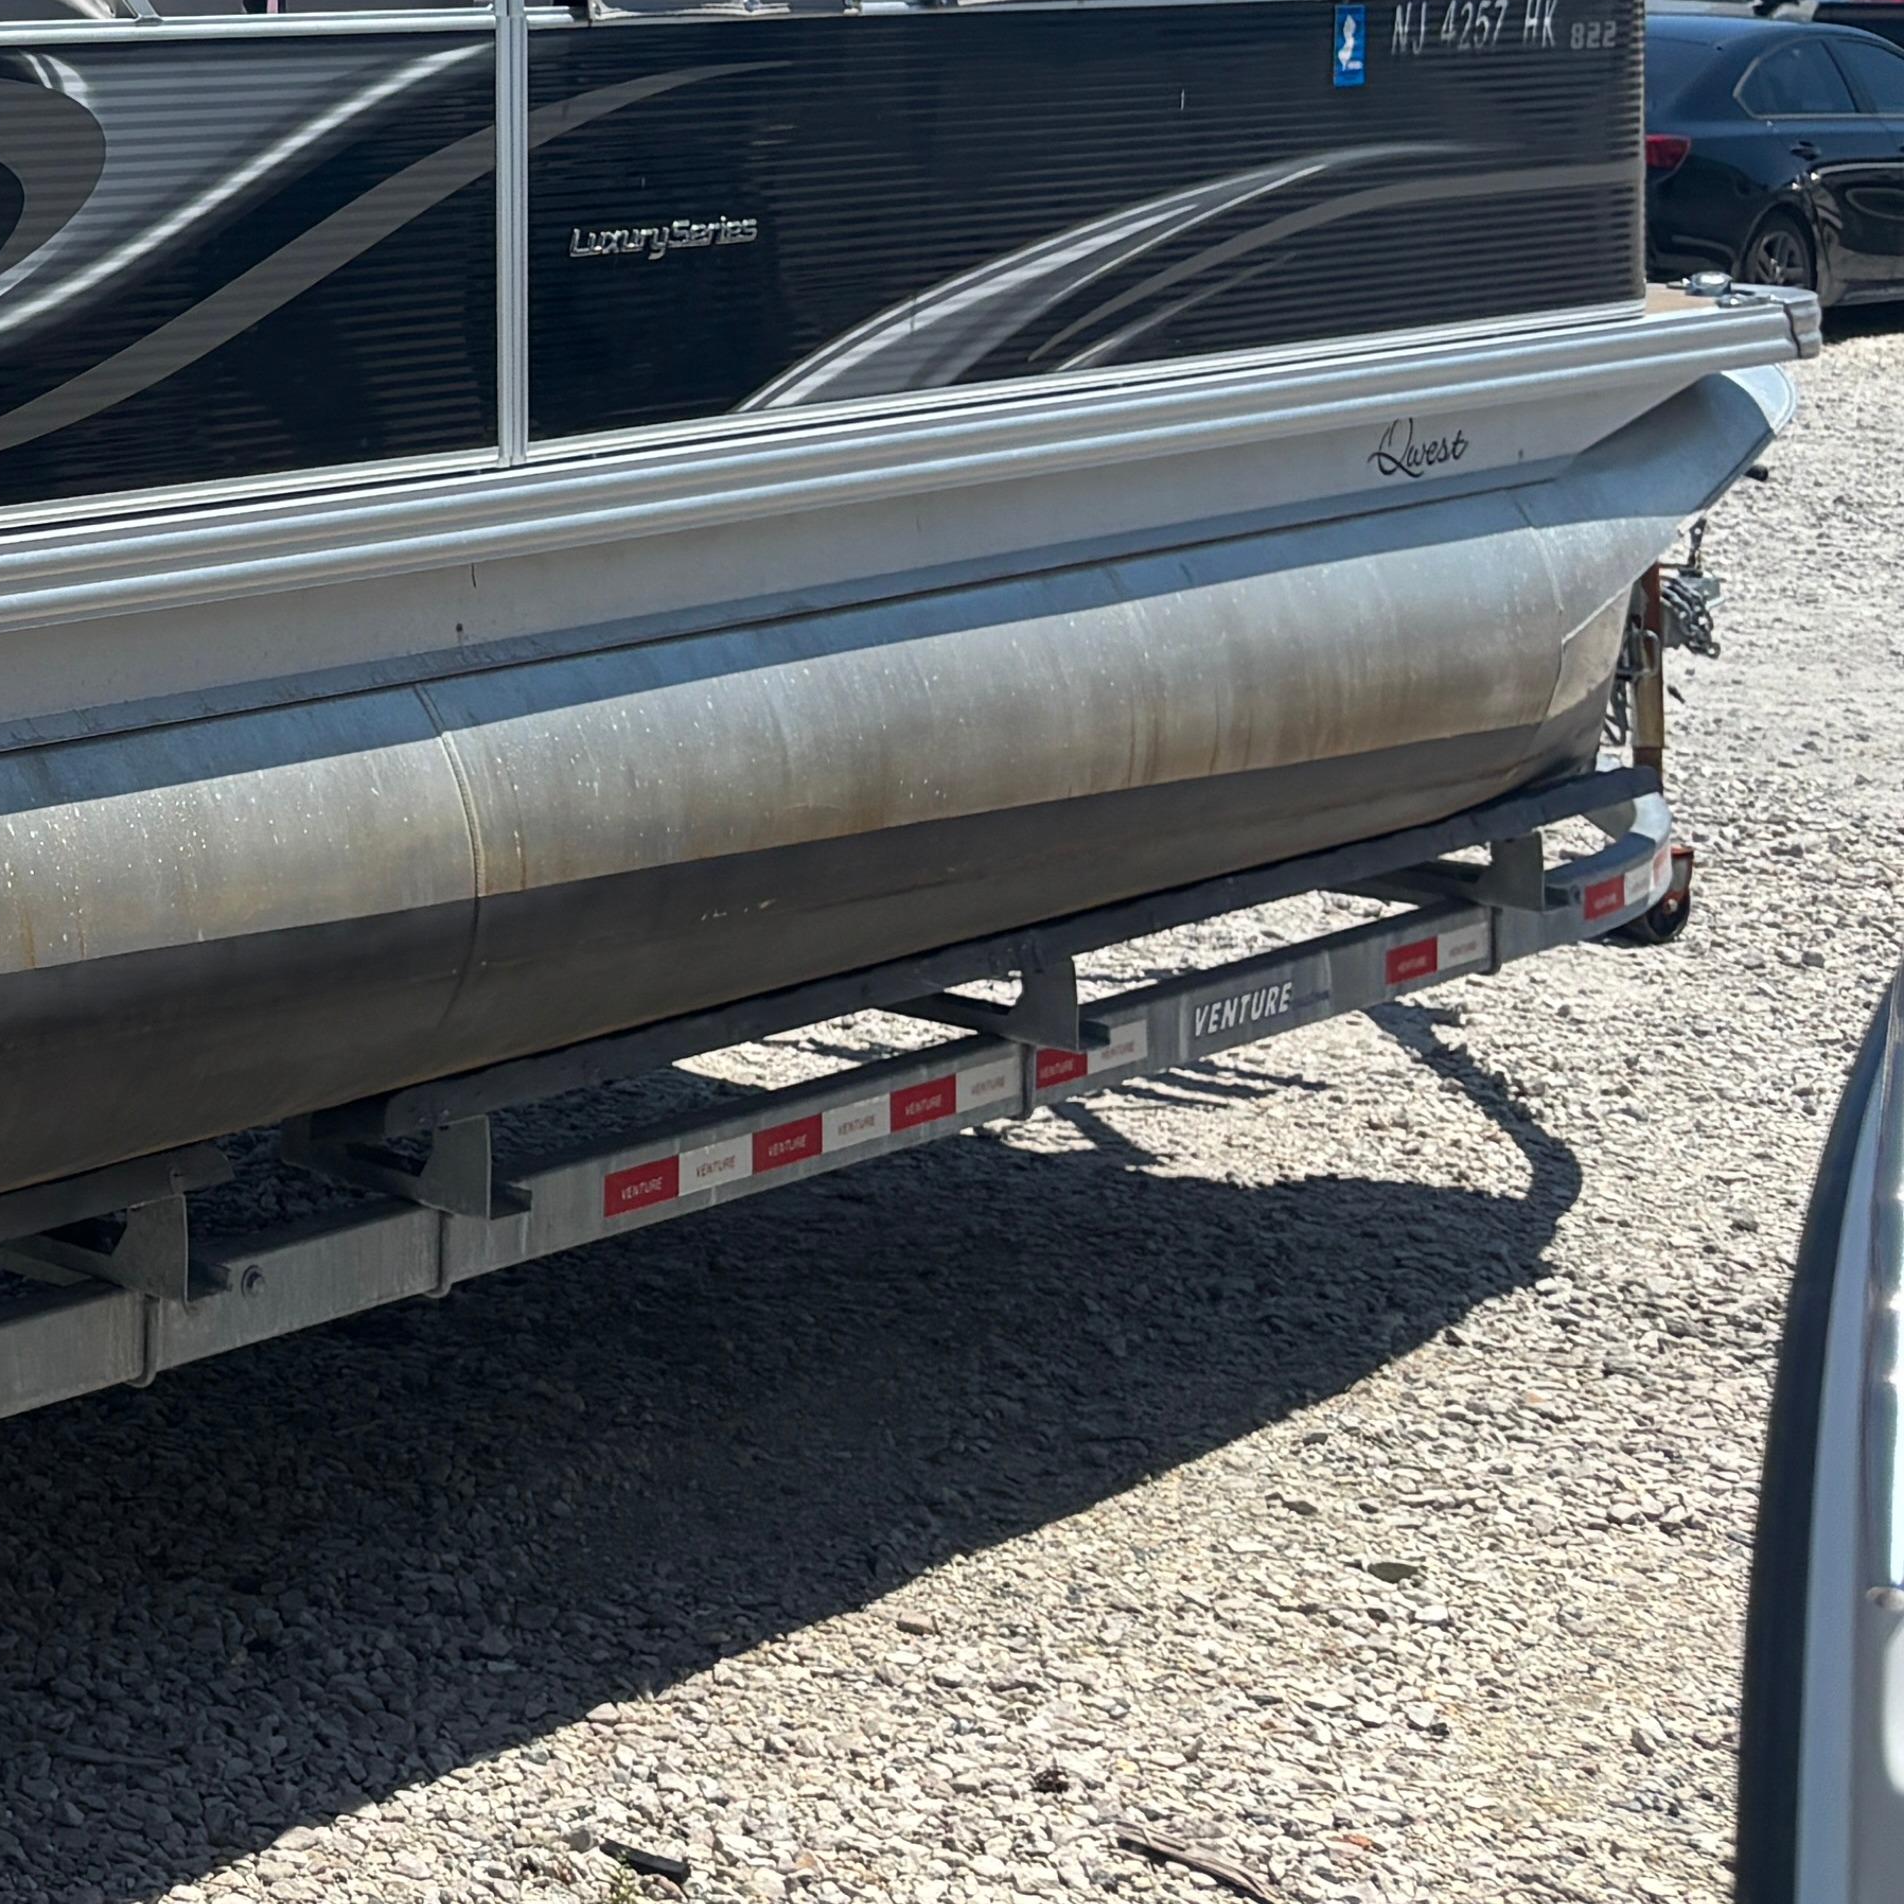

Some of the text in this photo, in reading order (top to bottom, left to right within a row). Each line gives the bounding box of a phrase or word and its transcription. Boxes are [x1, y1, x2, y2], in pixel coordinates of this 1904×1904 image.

[1392, 1, 1428, 55] NJ
[1367, 417, 1470, 478] Qwest
[1194, 981, 1293, 1037] VENTURE
[905, 1093, 943, 1116] VENTURE
[837, 1114, 876, 1136] VENTURE
[768, 1133, 807, 1157] VENTURE
[696, 1154, 737, 1178] VENTURE
[621, 1176, 664, 1200] VENTURE
